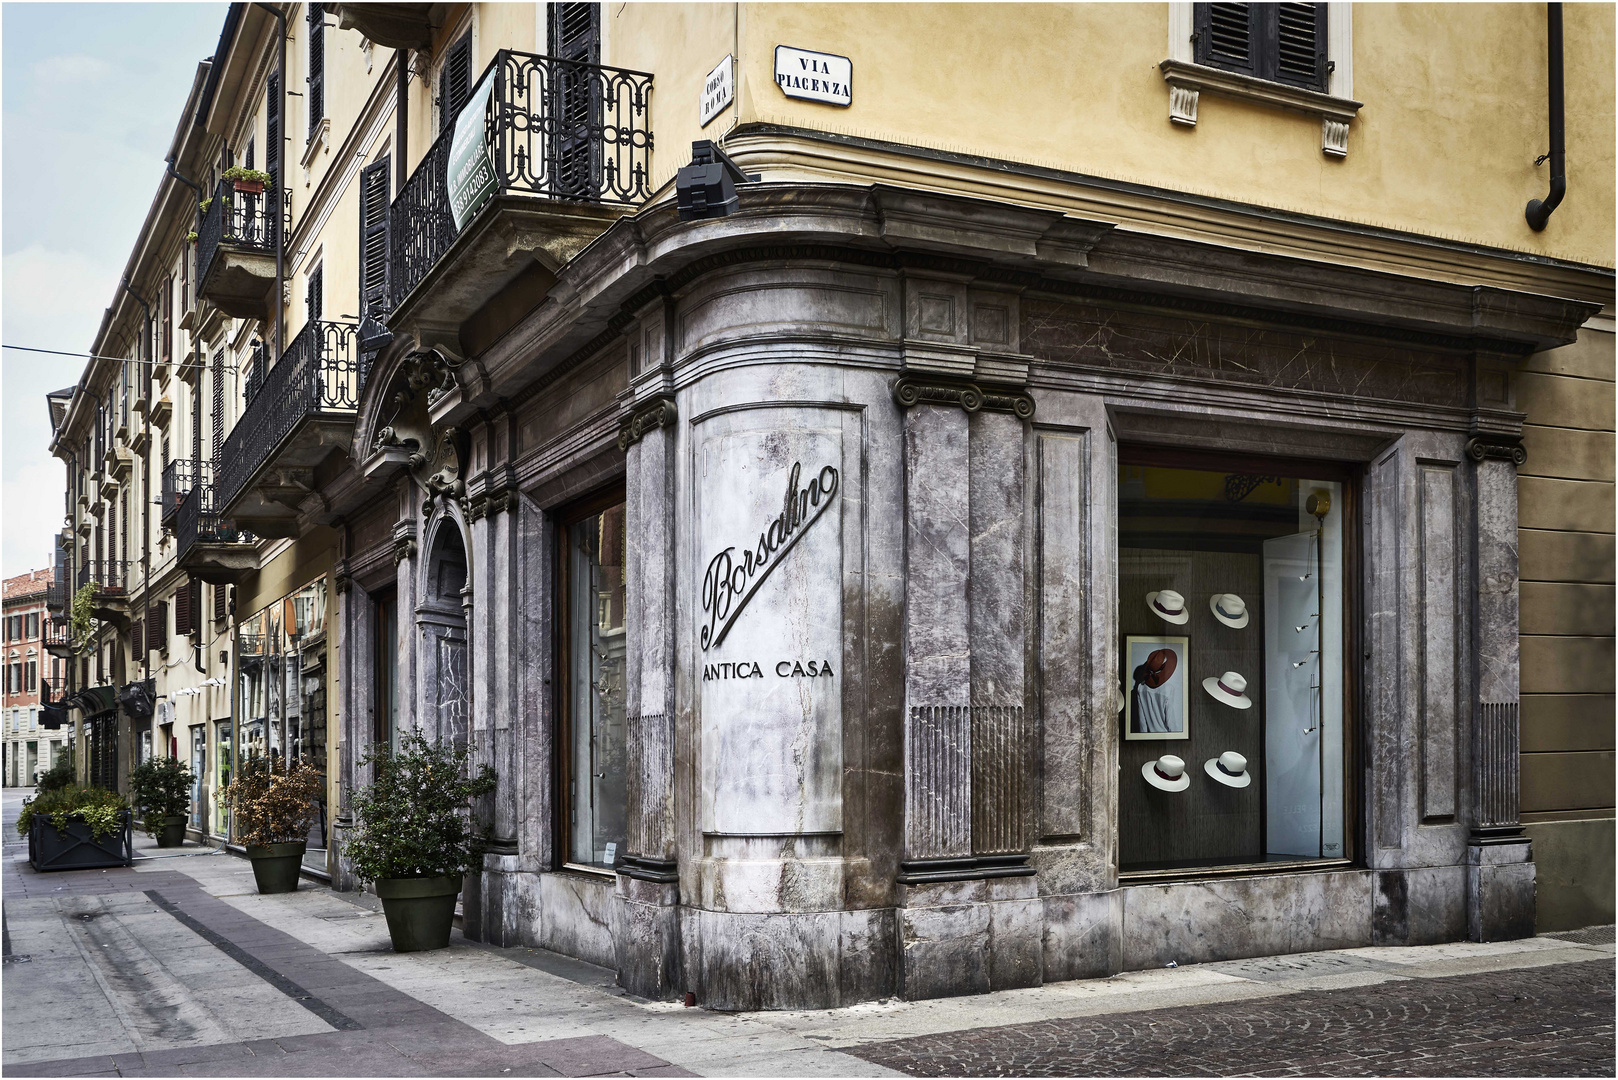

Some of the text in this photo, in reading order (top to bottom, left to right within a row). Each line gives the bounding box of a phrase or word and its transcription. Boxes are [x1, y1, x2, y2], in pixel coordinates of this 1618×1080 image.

[799, 57, 830, 75] VIA
[706, 70, 725, 95] CORSO
[777, 73, 850, 98] PIACENZA
[705, 86, 726, 115] ROMA
[457, 141, 485, 187] IMMOBILIARE
[701, 461, 838, 651] Borsalino
[702, 659, 834, 683] ANTICA CASA
